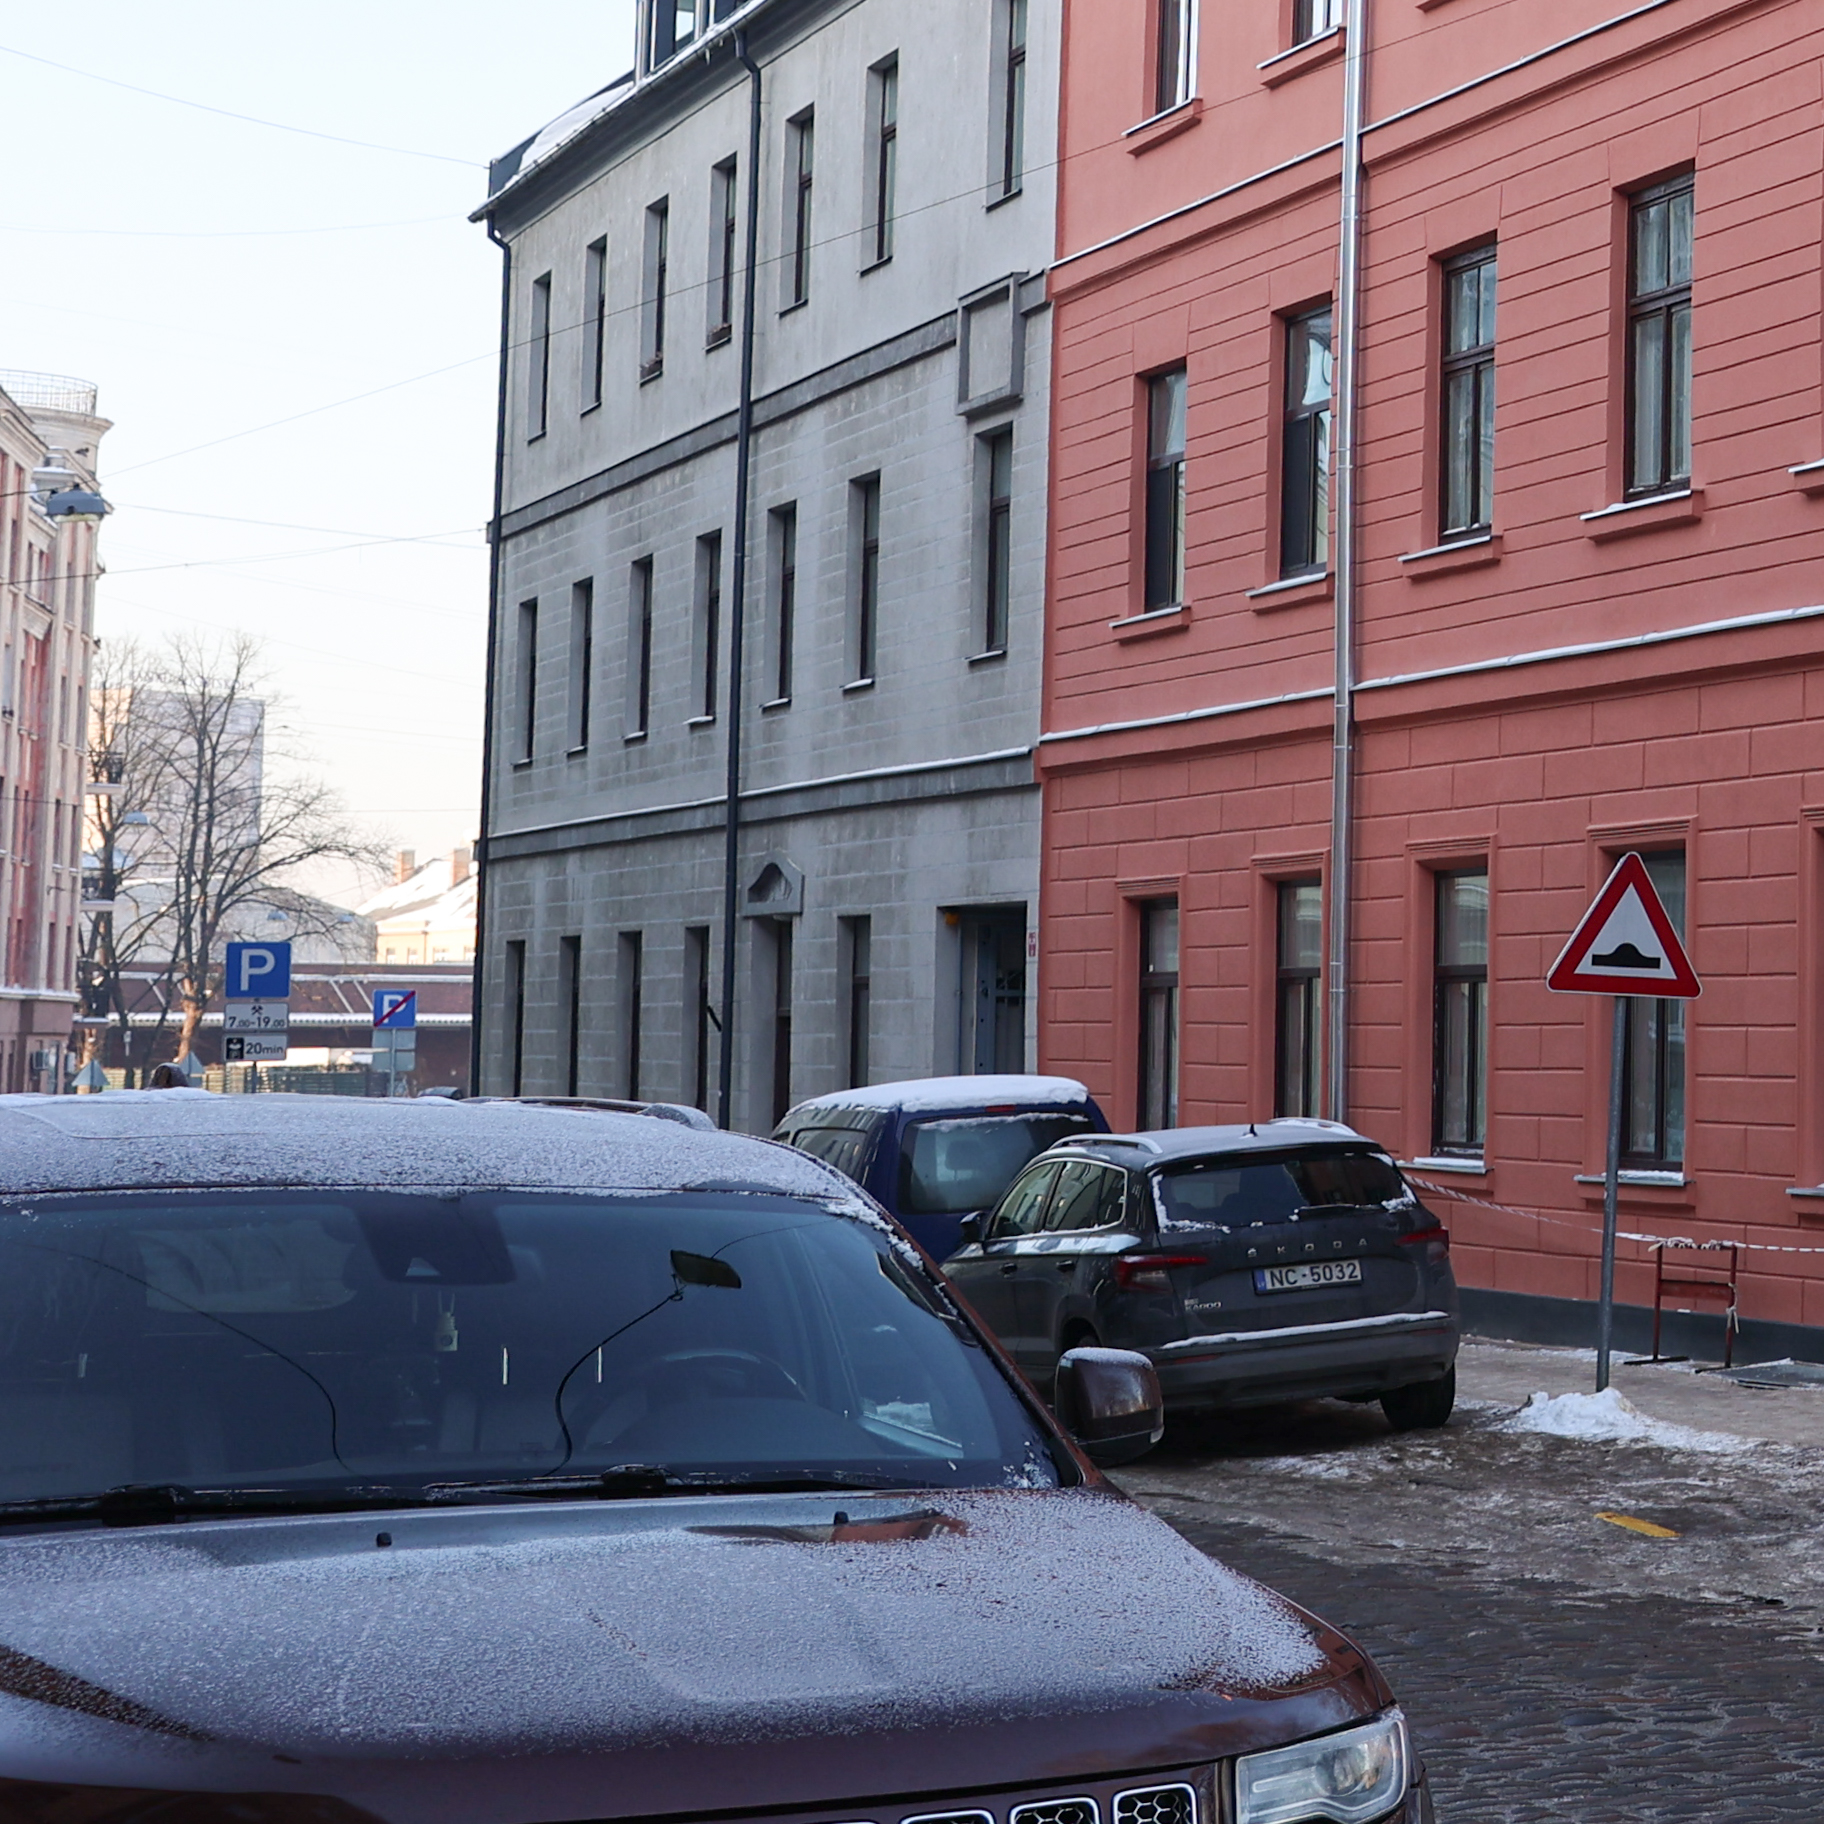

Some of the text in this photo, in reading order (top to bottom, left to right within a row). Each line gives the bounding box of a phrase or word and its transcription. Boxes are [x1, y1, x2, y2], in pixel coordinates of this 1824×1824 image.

[240, 948, 276, 992] P
[382, 993, 408, 1024] P
[1269, 1262, 1358, 1287] NC-5032
